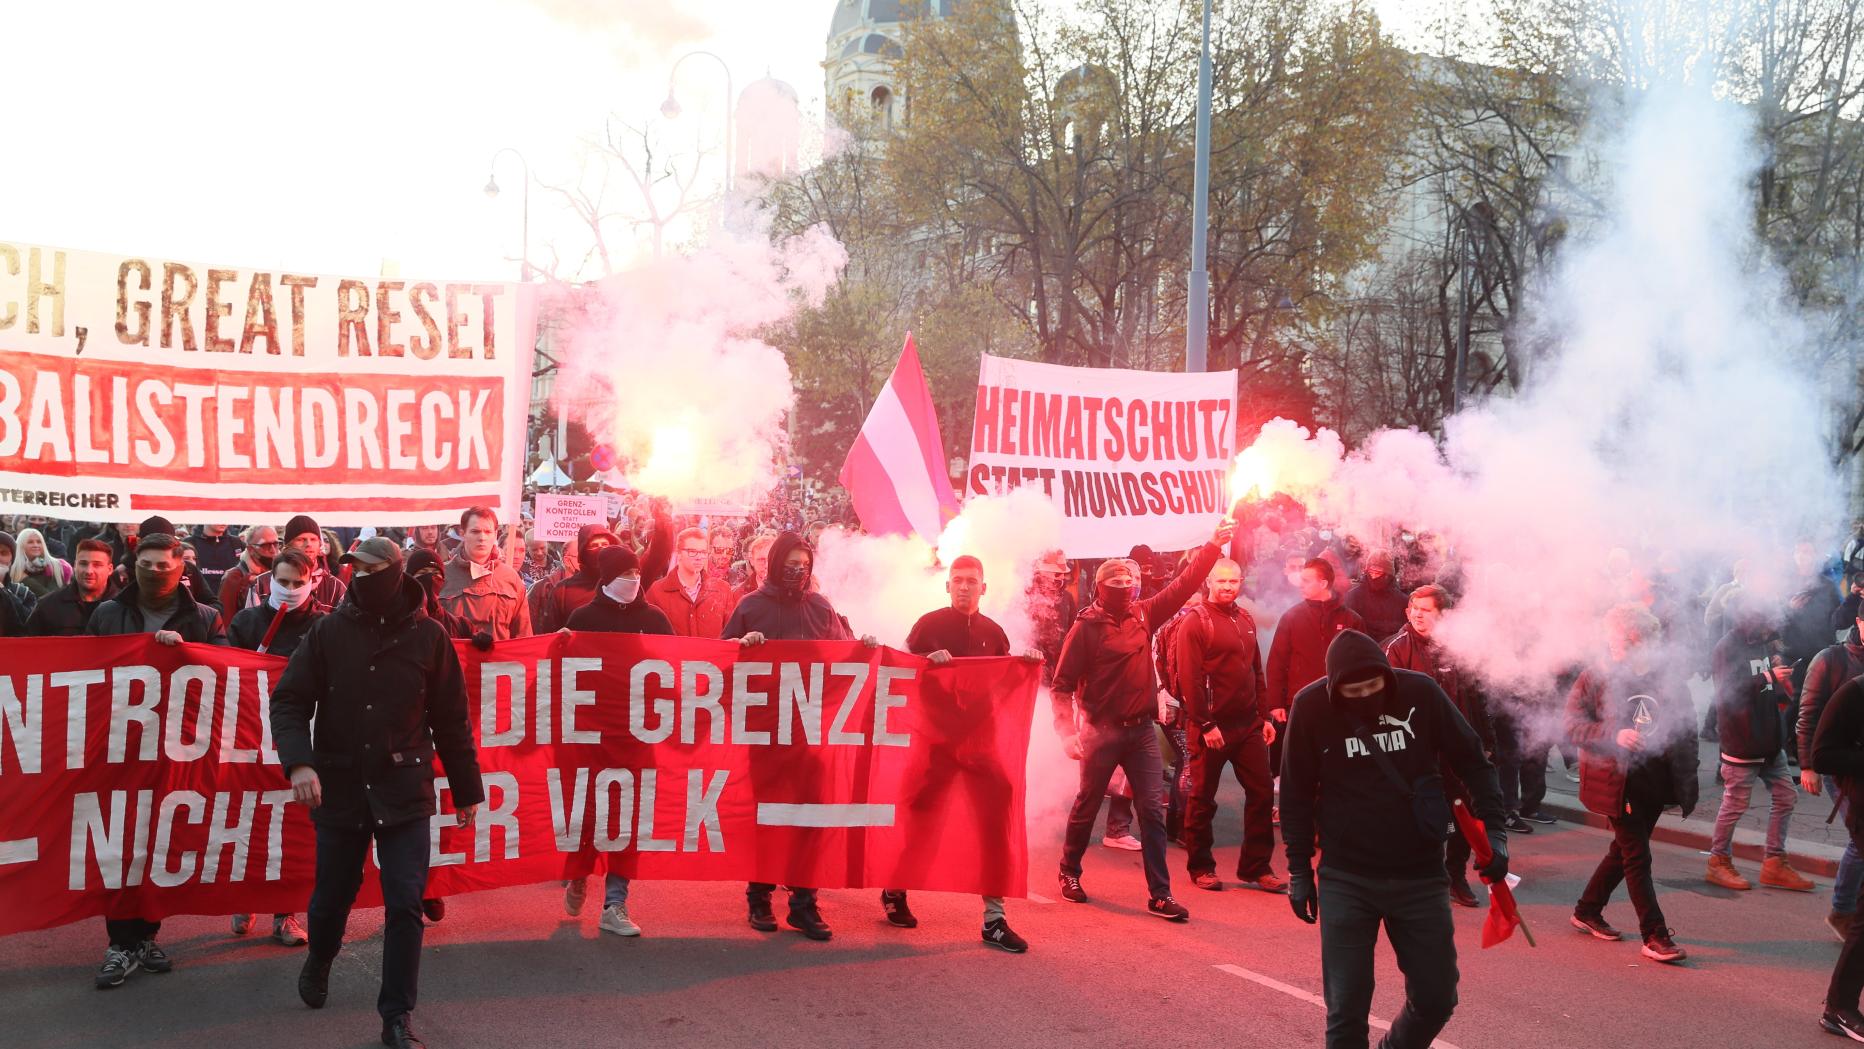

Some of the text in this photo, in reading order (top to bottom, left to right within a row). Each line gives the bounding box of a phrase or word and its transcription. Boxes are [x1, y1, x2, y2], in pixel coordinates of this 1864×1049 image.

[114, 258, 318, 356] GREAT
[336, 279, 505, 360] RESET
[974, 385, 1231, 462] HEIMATSCHUTZ
[545, 507, 597, 517] KONTROLLEN
[557, 500, 586, 508] GRENZ-
[0, 657, 917, 775] NTROLL DIE GRENZE
[68, 767, 730, 891] NICHT ER VOLK
